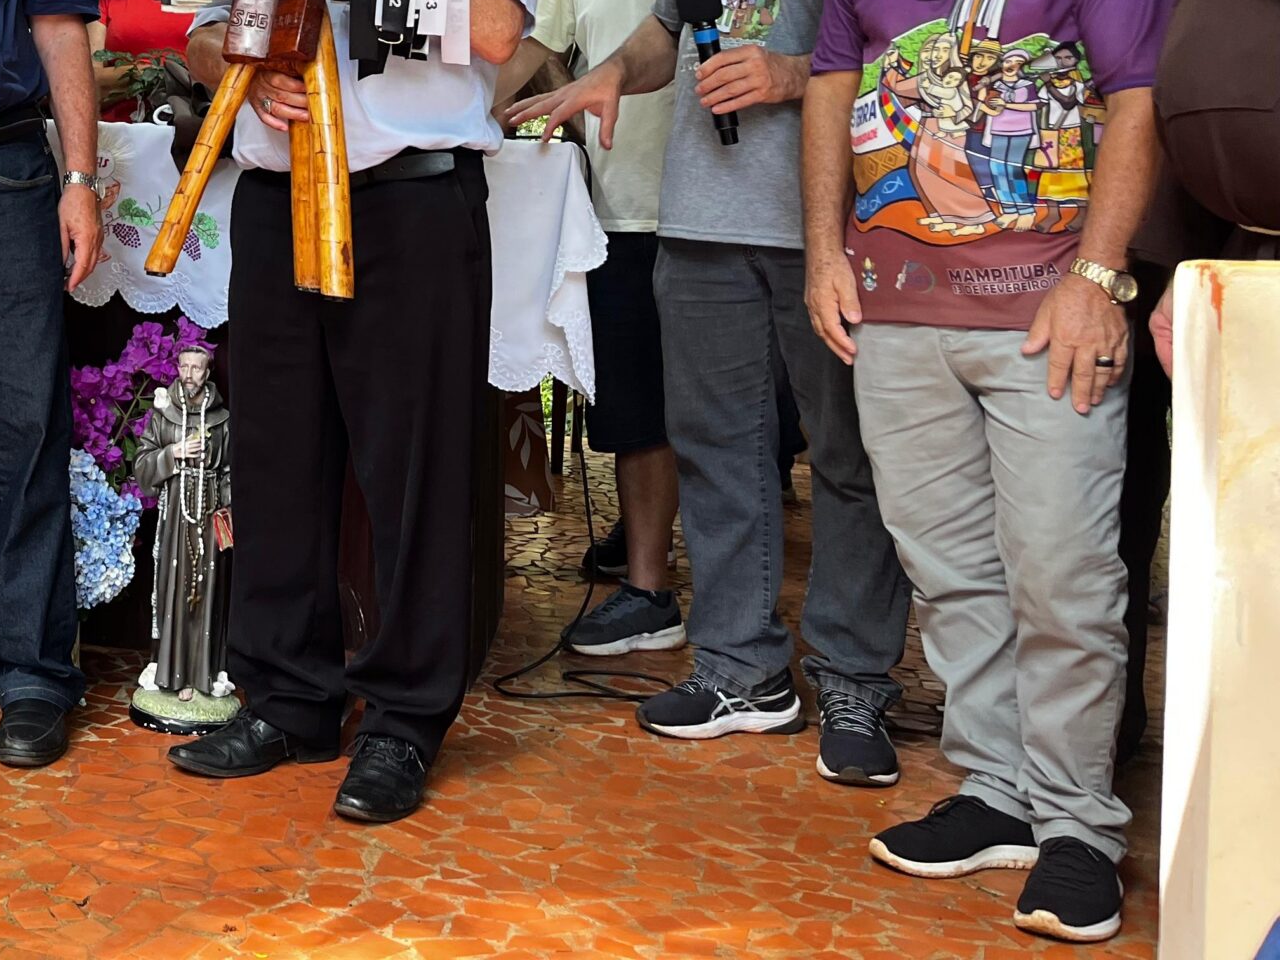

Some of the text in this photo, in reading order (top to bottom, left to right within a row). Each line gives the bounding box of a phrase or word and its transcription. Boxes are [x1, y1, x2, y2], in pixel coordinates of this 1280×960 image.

[948, 263, 1059, 283] MAMPITUBA
[965, 285, 980, 295] DE
[983, 280, 1050, 294] FEVEREIRO
